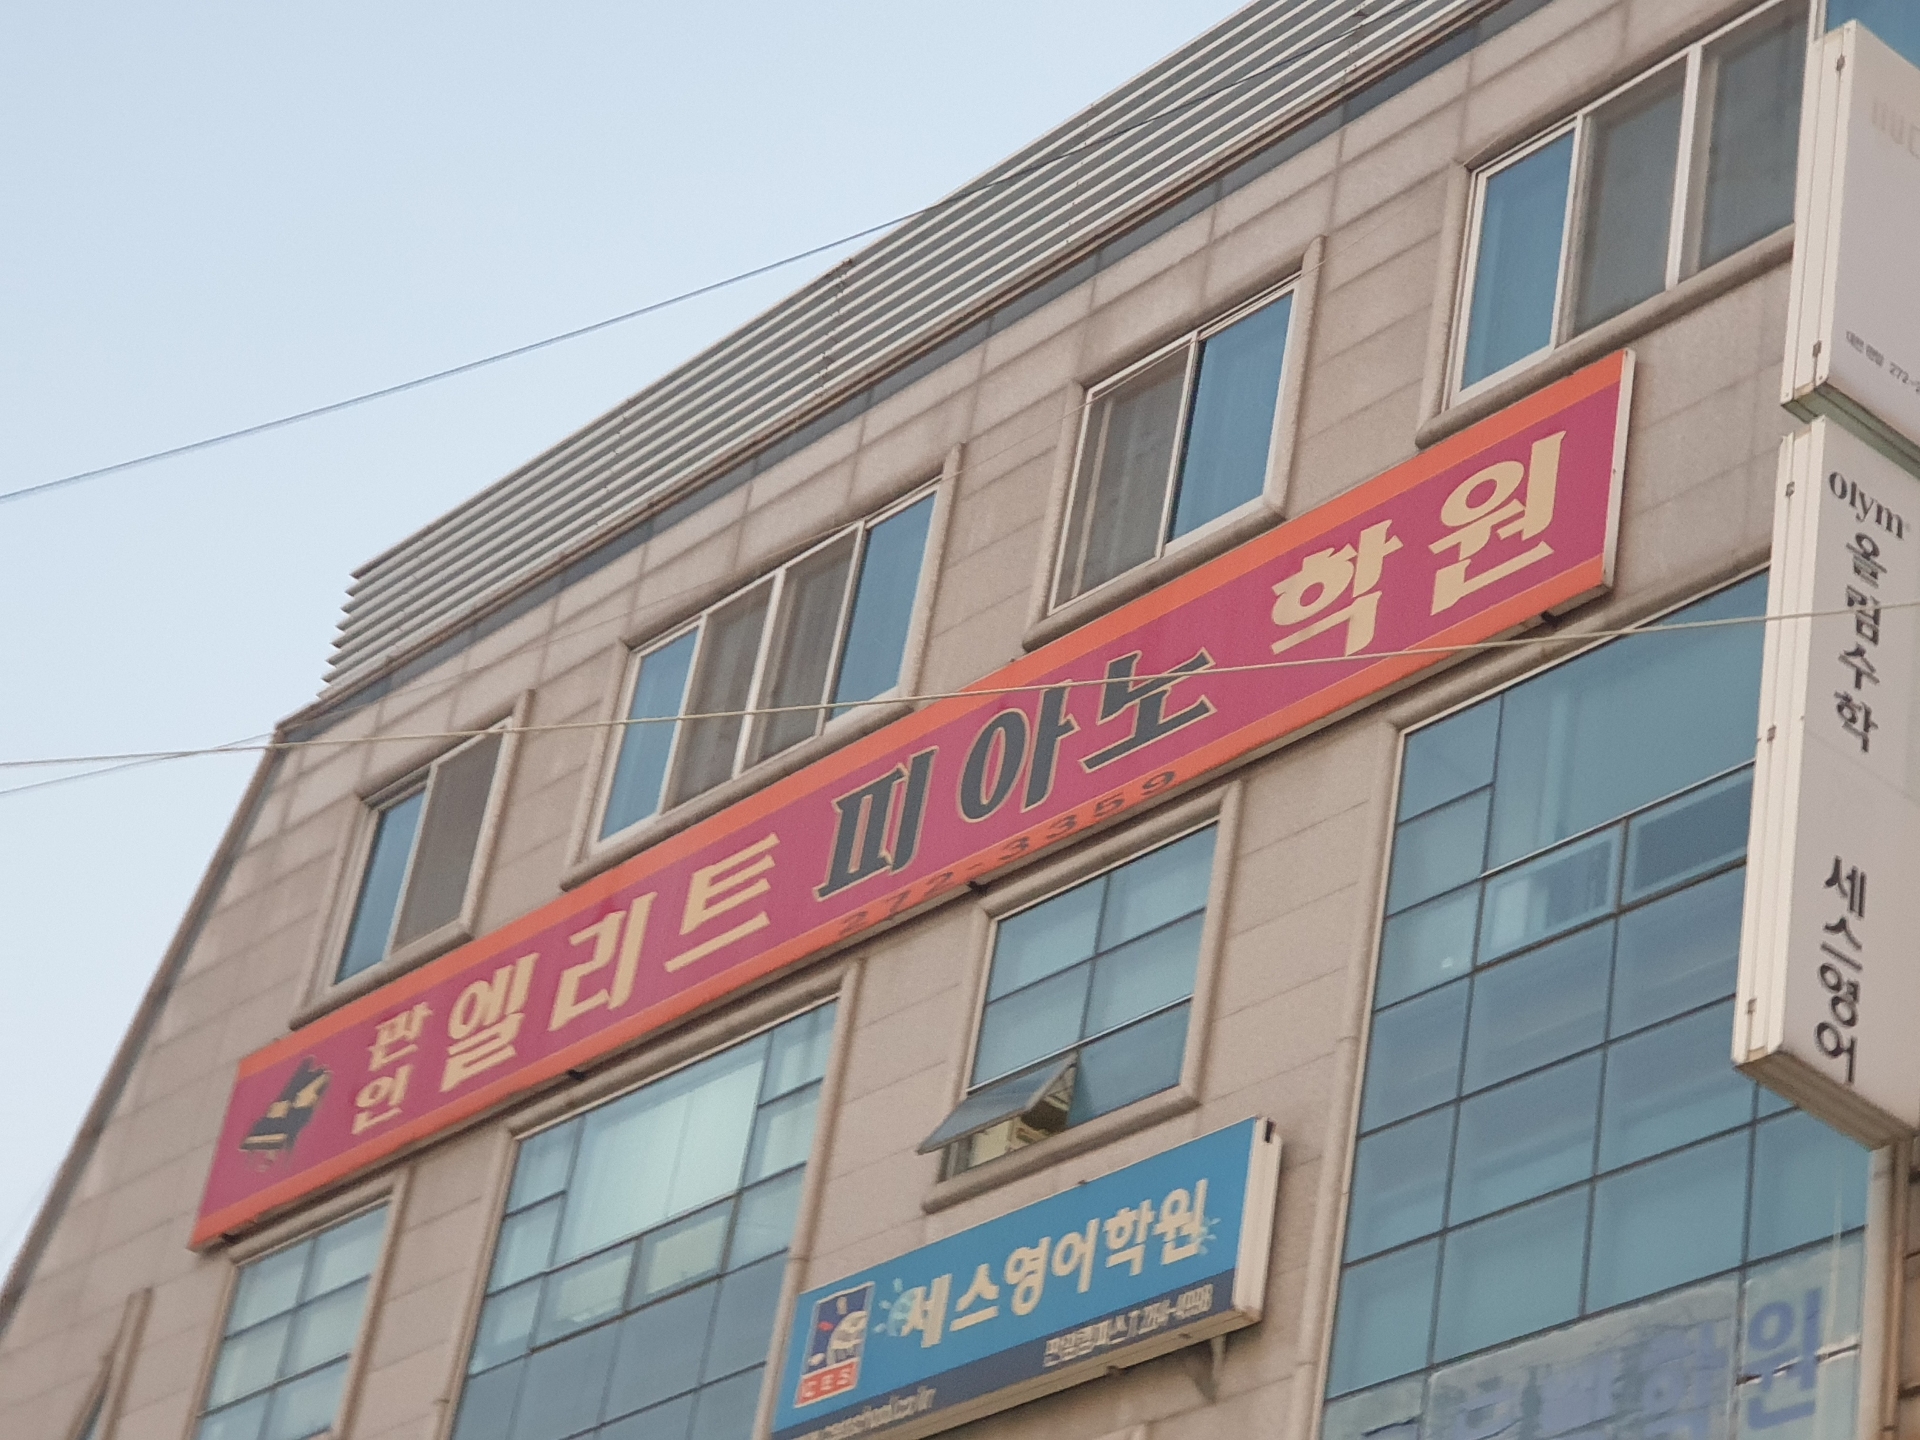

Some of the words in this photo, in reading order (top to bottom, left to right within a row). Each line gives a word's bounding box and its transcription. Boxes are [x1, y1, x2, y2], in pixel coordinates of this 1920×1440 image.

[1829, 472, 1904, 540] olym
[440, 832, 781, 1092] 엘리트
[812, 647, 1217, 901] 피아노
[1271, 430, 1566, 657] 학원
[837, 770, 1175, 939] 272-3359
[1814, 855, 1867, 1085] 세스영어
